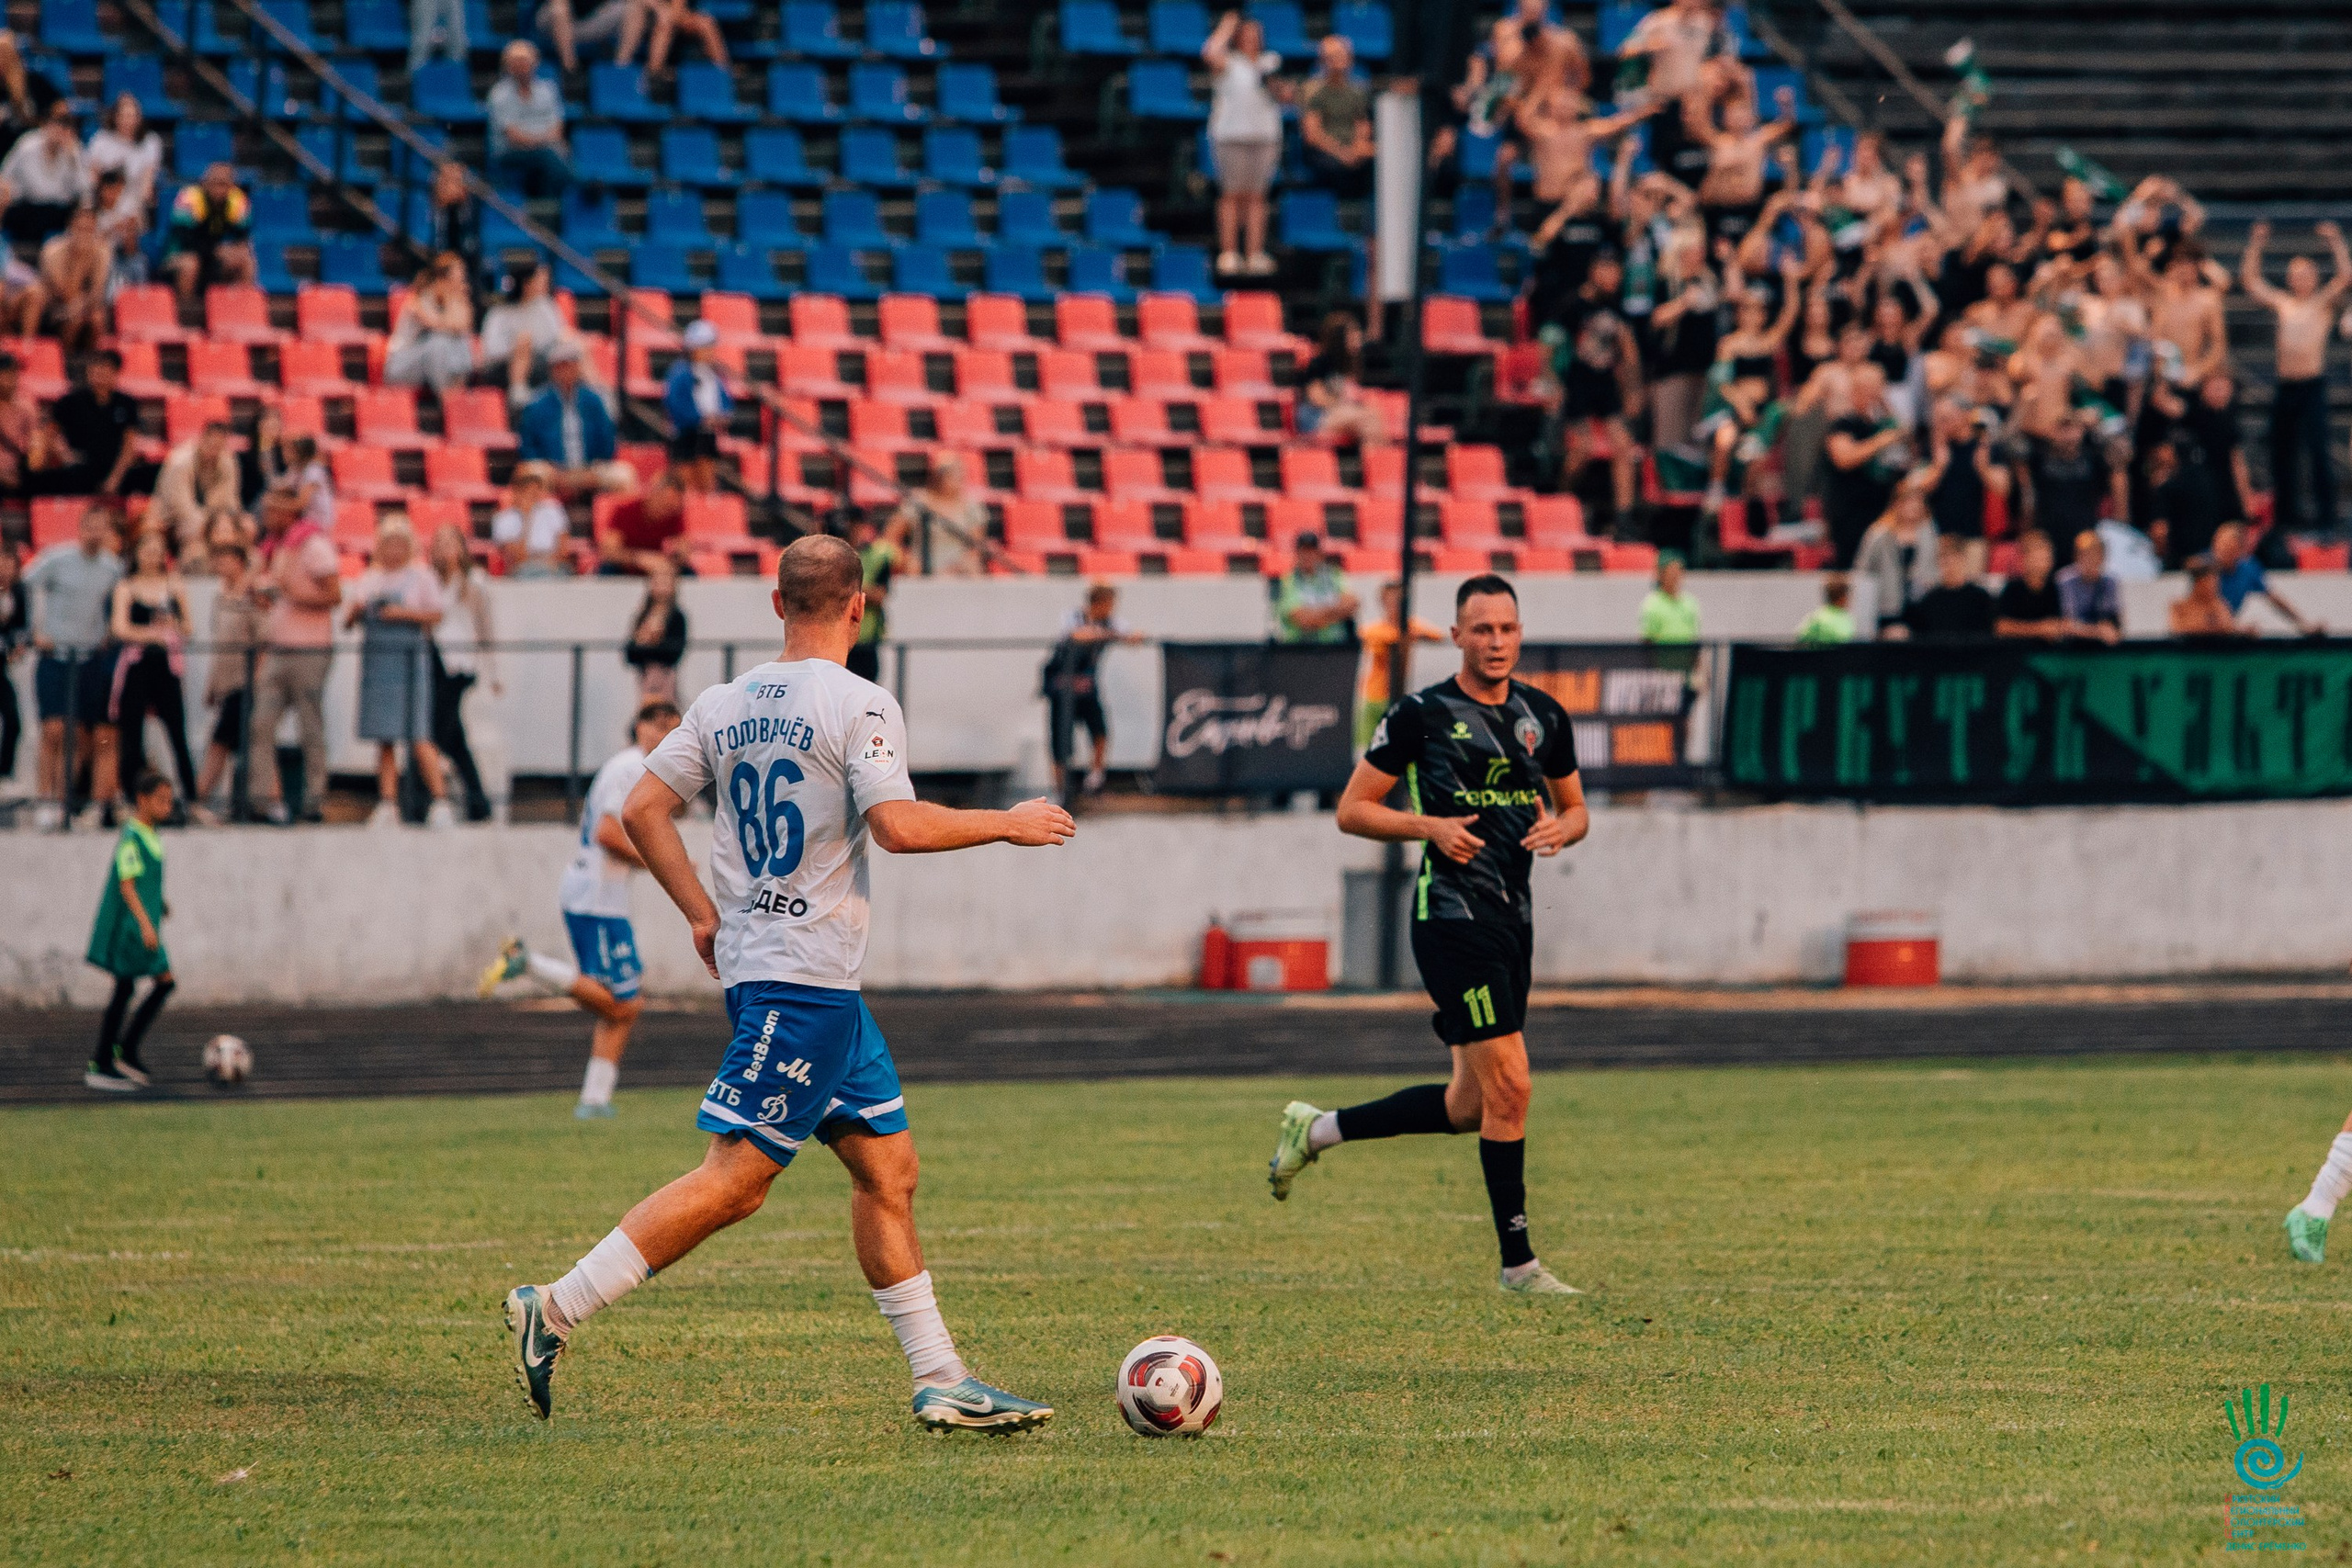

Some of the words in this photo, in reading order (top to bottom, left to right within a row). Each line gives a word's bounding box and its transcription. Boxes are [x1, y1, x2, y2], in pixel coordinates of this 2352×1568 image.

[756, 683, 787, 699] ВТБ
[714, 716, 814, 755] ГОЛОВАЧЁВ
[729, 758, 805, 878] 86
[1463, 985, 1497, 1028] 11
[742, 1010, 780, 1083] BetBoom
[707, 1077, 742, 1107] ВТБ
